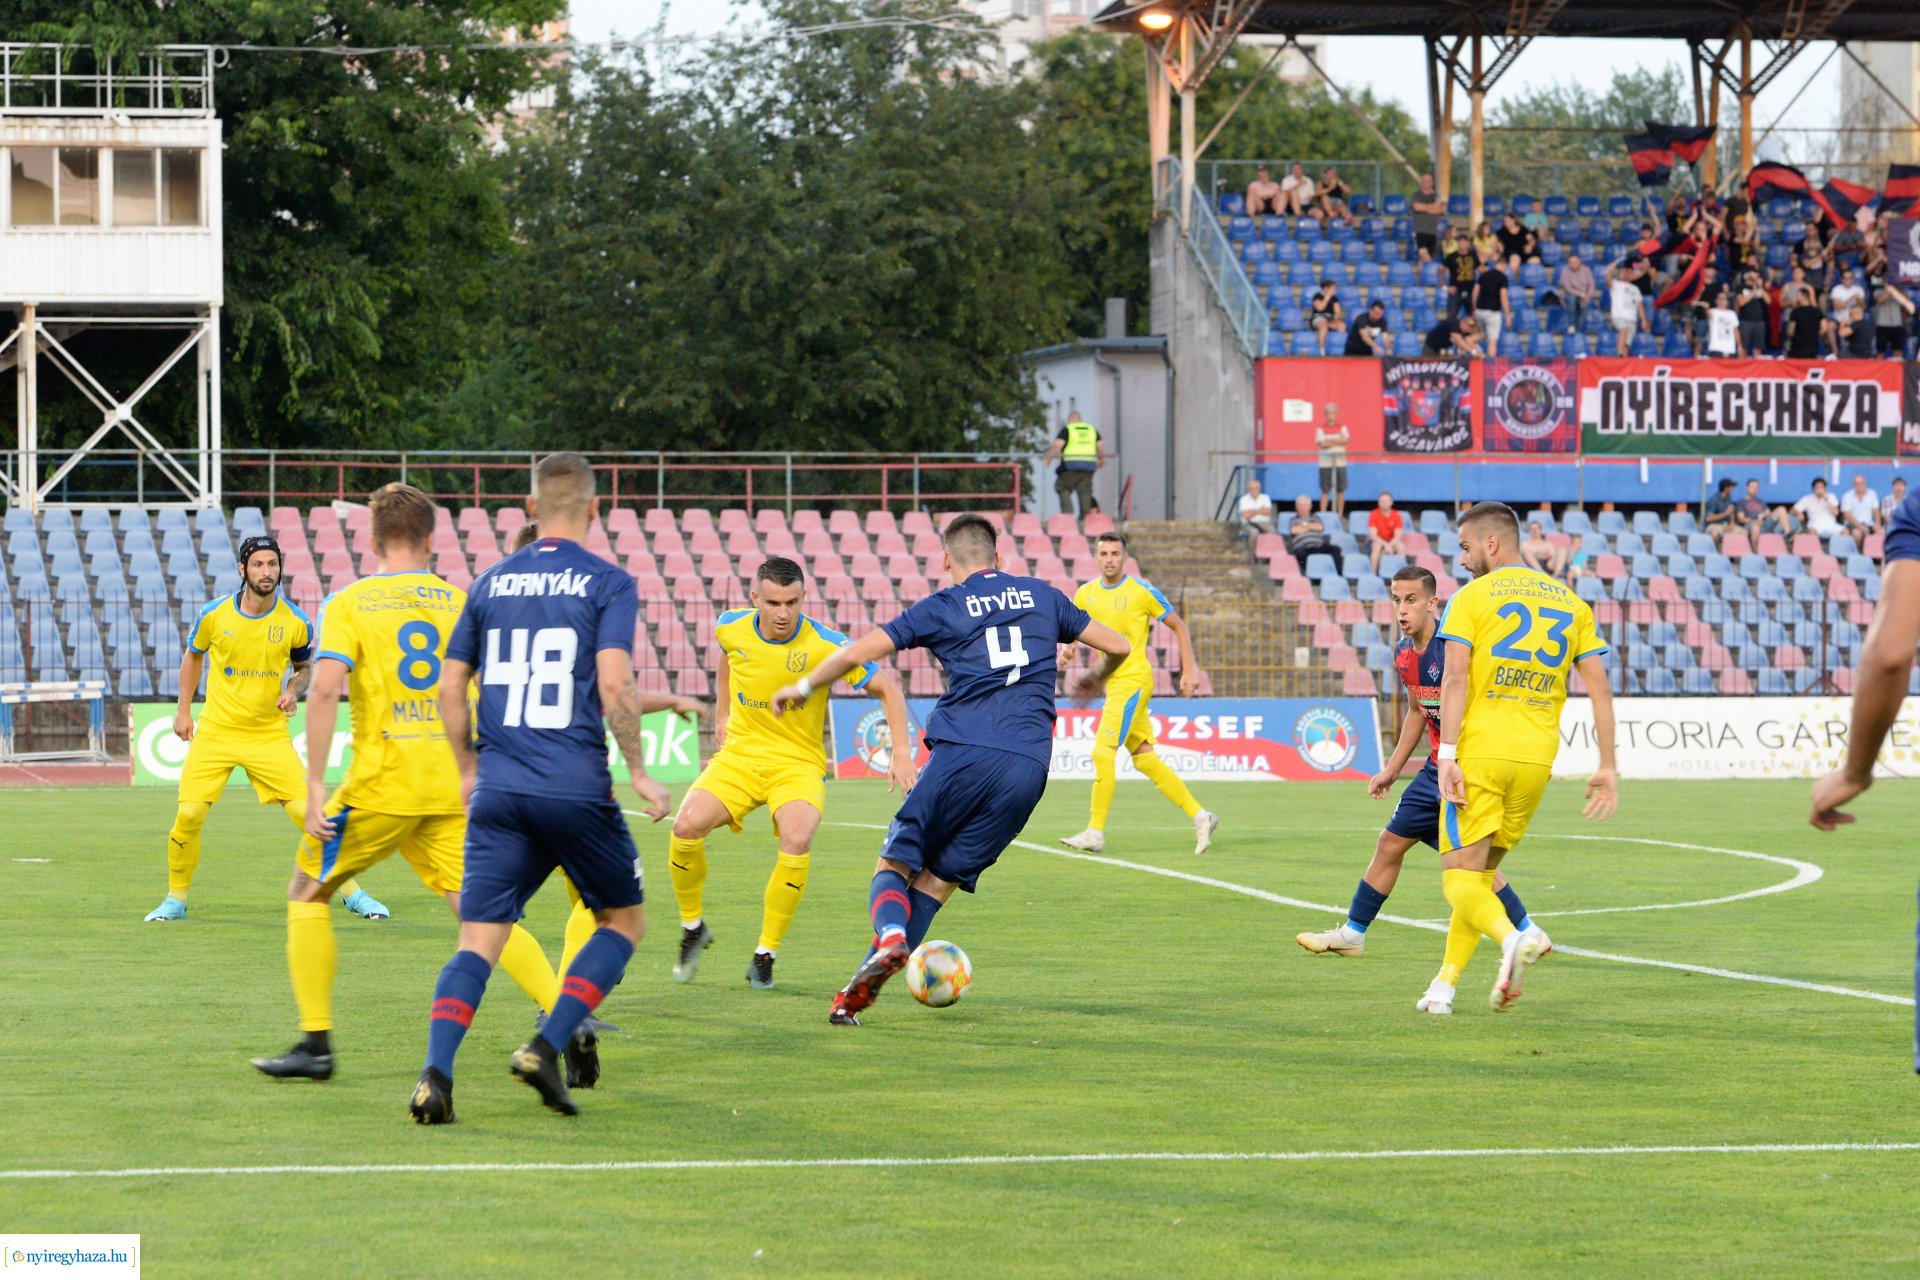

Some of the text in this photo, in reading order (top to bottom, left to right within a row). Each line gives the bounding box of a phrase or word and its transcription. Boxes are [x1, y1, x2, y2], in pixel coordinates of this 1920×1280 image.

[1597, 365, 1882, 438] NYÍREGYHÁZA
[488, 568, 592, 599] HORNYÁK
[966, 587, 1035, 617] ÖTVÖS
[1491, 601, 1574, 668] 23
[397, 620, 441, 691] 8
[985, 626, 1030, 687] 4
[483, 627, 578, 729] 48
[1495, 666, 1556, 694] BERECZKI
[746, 698, 804, 712] GREELAN
[1148, 709, 1263, 739] ÓZSEF
[1668, 760, 1722, 771] HOTEL
